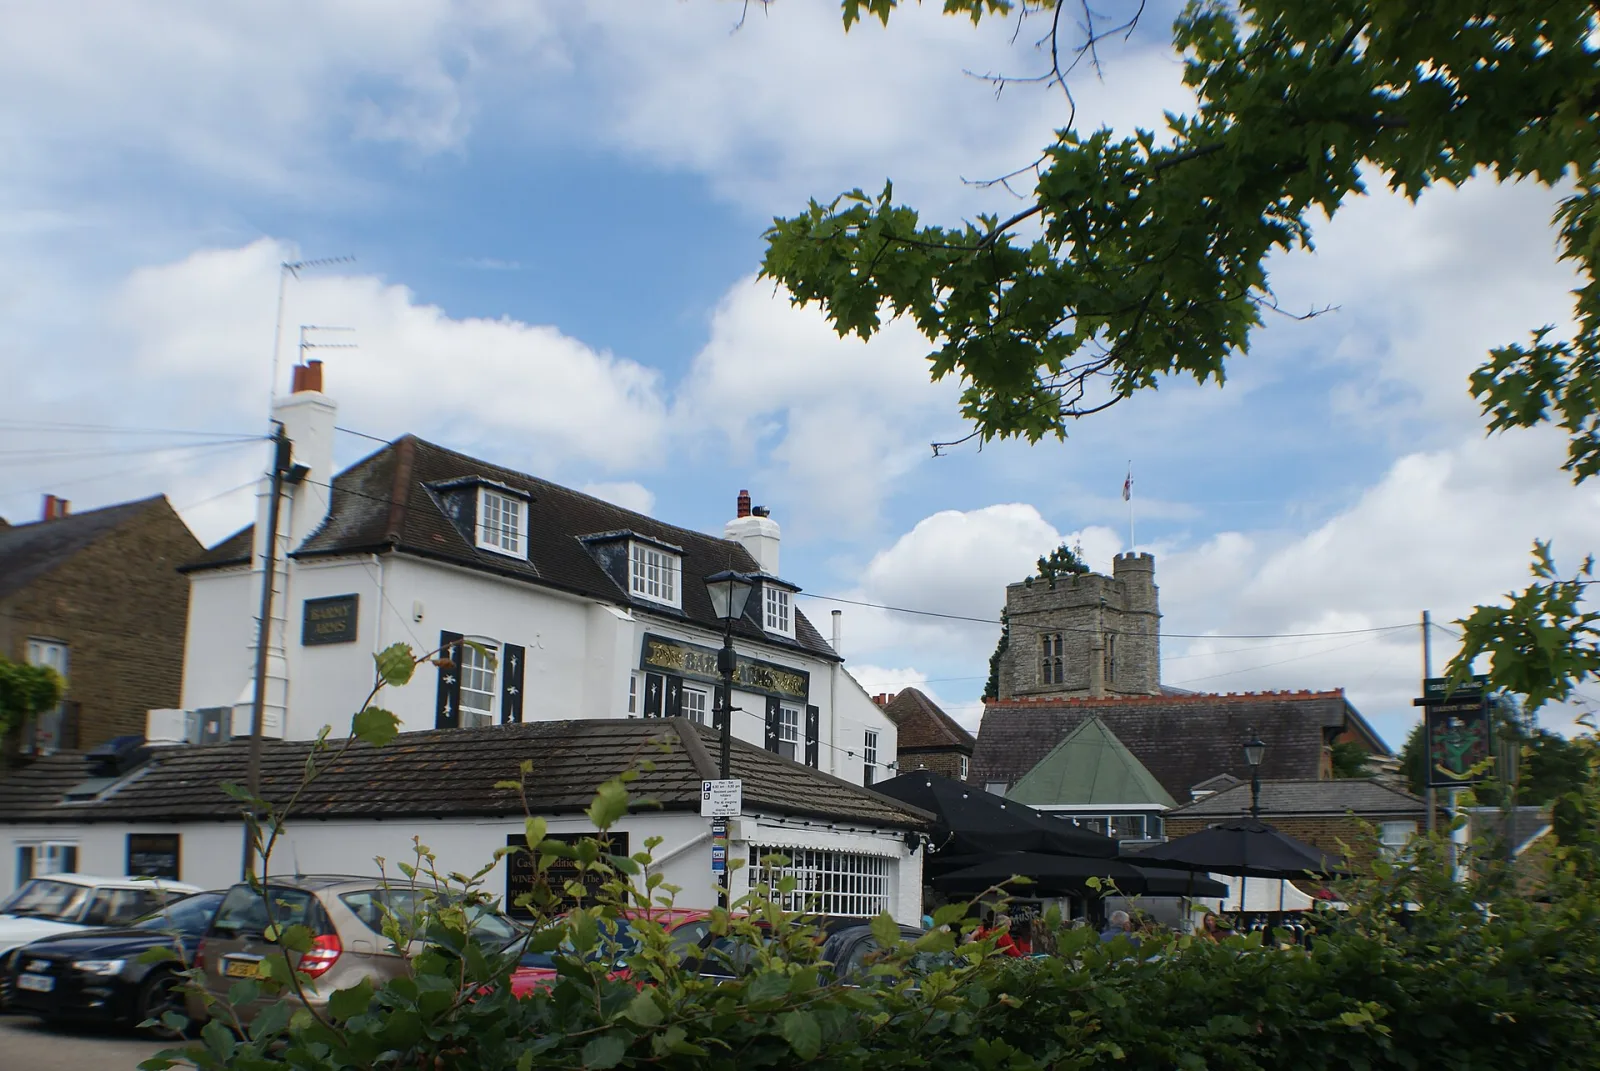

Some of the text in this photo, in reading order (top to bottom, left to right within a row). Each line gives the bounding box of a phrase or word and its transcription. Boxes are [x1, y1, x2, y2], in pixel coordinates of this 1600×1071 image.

[516, 858, 537, 868] Cas
[511, 874, 536, 883] WINES
[586, 874, 600, 883] The
